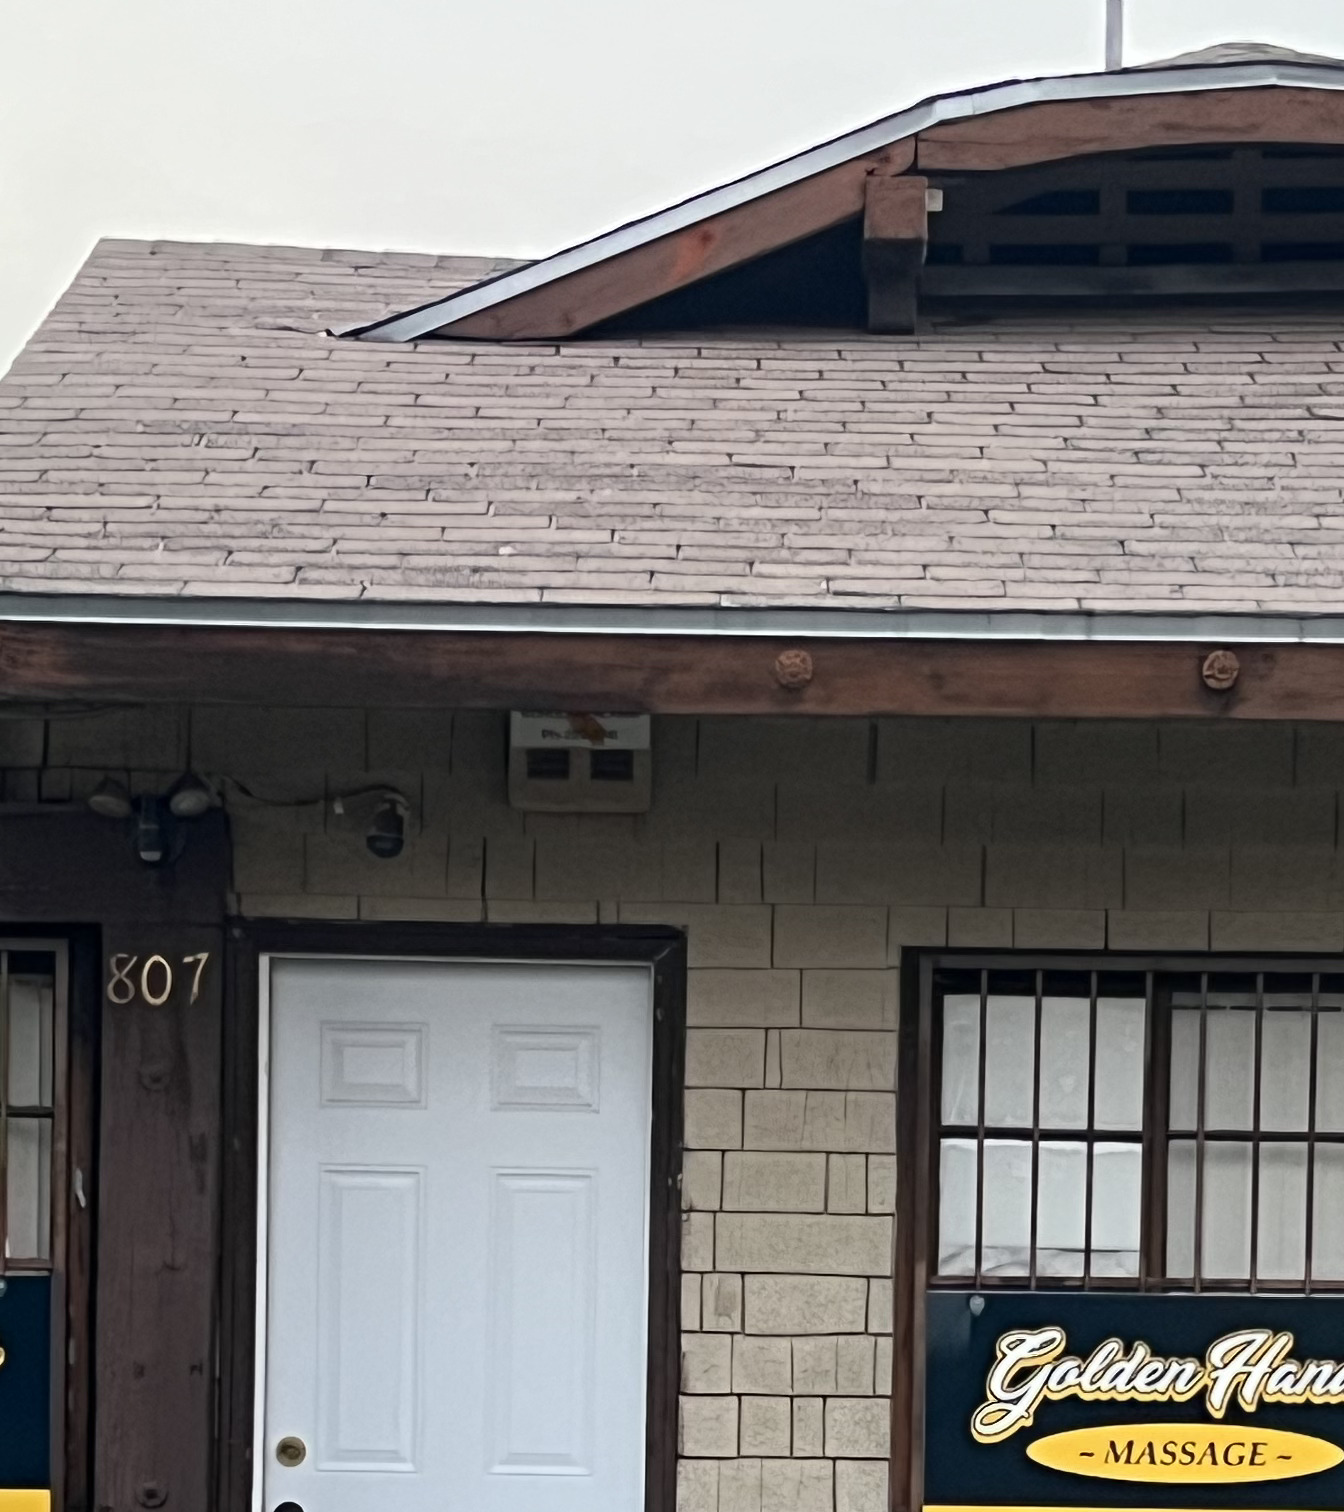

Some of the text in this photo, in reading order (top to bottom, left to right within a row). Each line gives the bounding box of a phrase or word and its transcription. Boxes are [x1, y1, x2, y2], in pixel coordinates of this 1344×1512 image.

[107, 952, 209, 1006] 807
[971, 1326, 1206, 1443] Golden
[1103, 1440, 1267, 1467] MASSAGE
